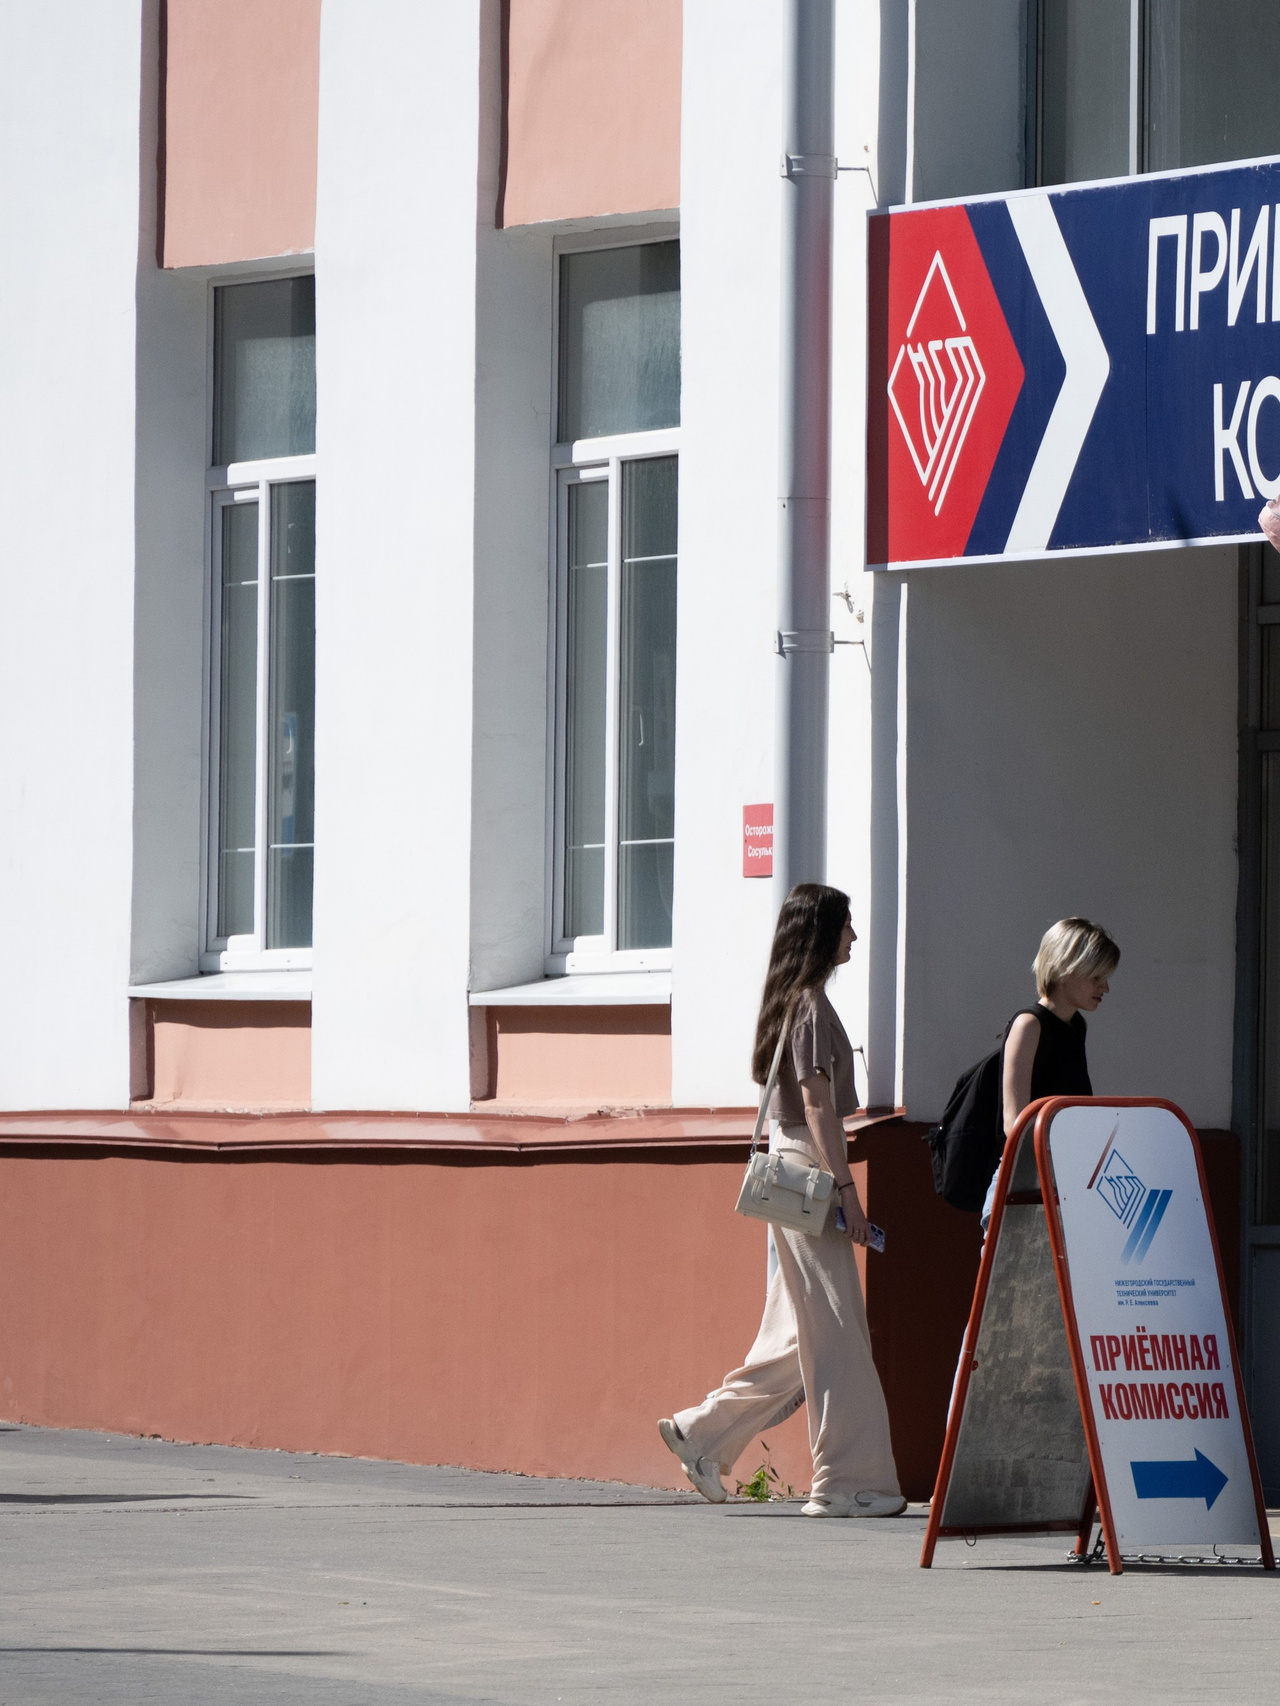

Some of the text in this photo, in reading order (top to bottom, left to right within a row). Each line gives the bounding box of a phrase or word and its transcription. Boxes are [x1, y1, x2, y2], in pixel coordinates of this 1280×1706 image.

[1114, 1278, 1195, 1286] НИЖЕГОРОДСКИЙ ГОСУДАРСТВЕННЫЙ
[1116, 1289, 1177, 1297] ТЕХНИЧЕСКИЙ УНИВЕРСИТЕТ
[1090, 1326, 1221, 1371] ПРИЁМНАЯ
[1099, 1382, 1230, 1420] КОМИССИЯ
